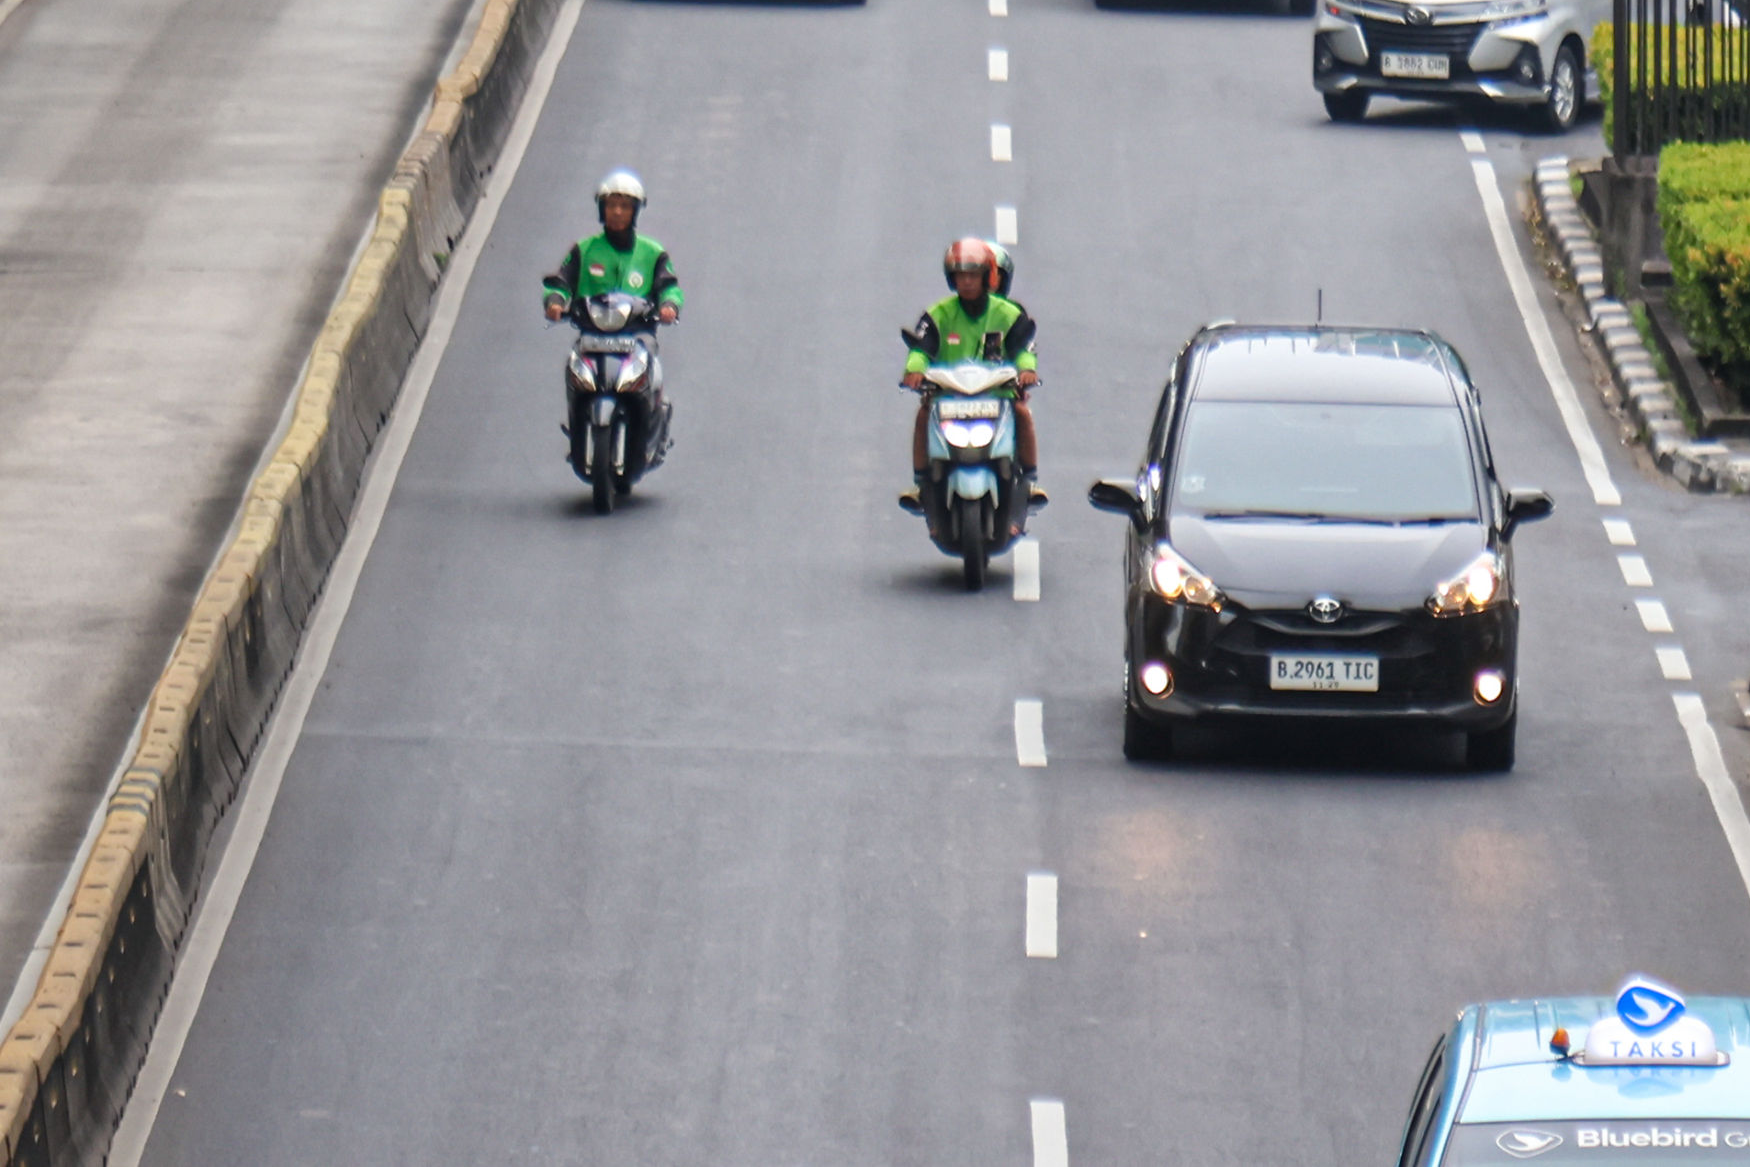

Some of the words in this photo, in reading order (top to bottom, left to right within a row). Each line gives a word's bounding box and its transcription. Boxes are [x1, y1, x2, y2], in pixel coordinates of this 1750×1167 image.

[1343, 662, 1374, 680] TIC
[1609, 1041, 1696, 1058] TAKSI
[1577, 1127, 1718, 1148] Bluebird
